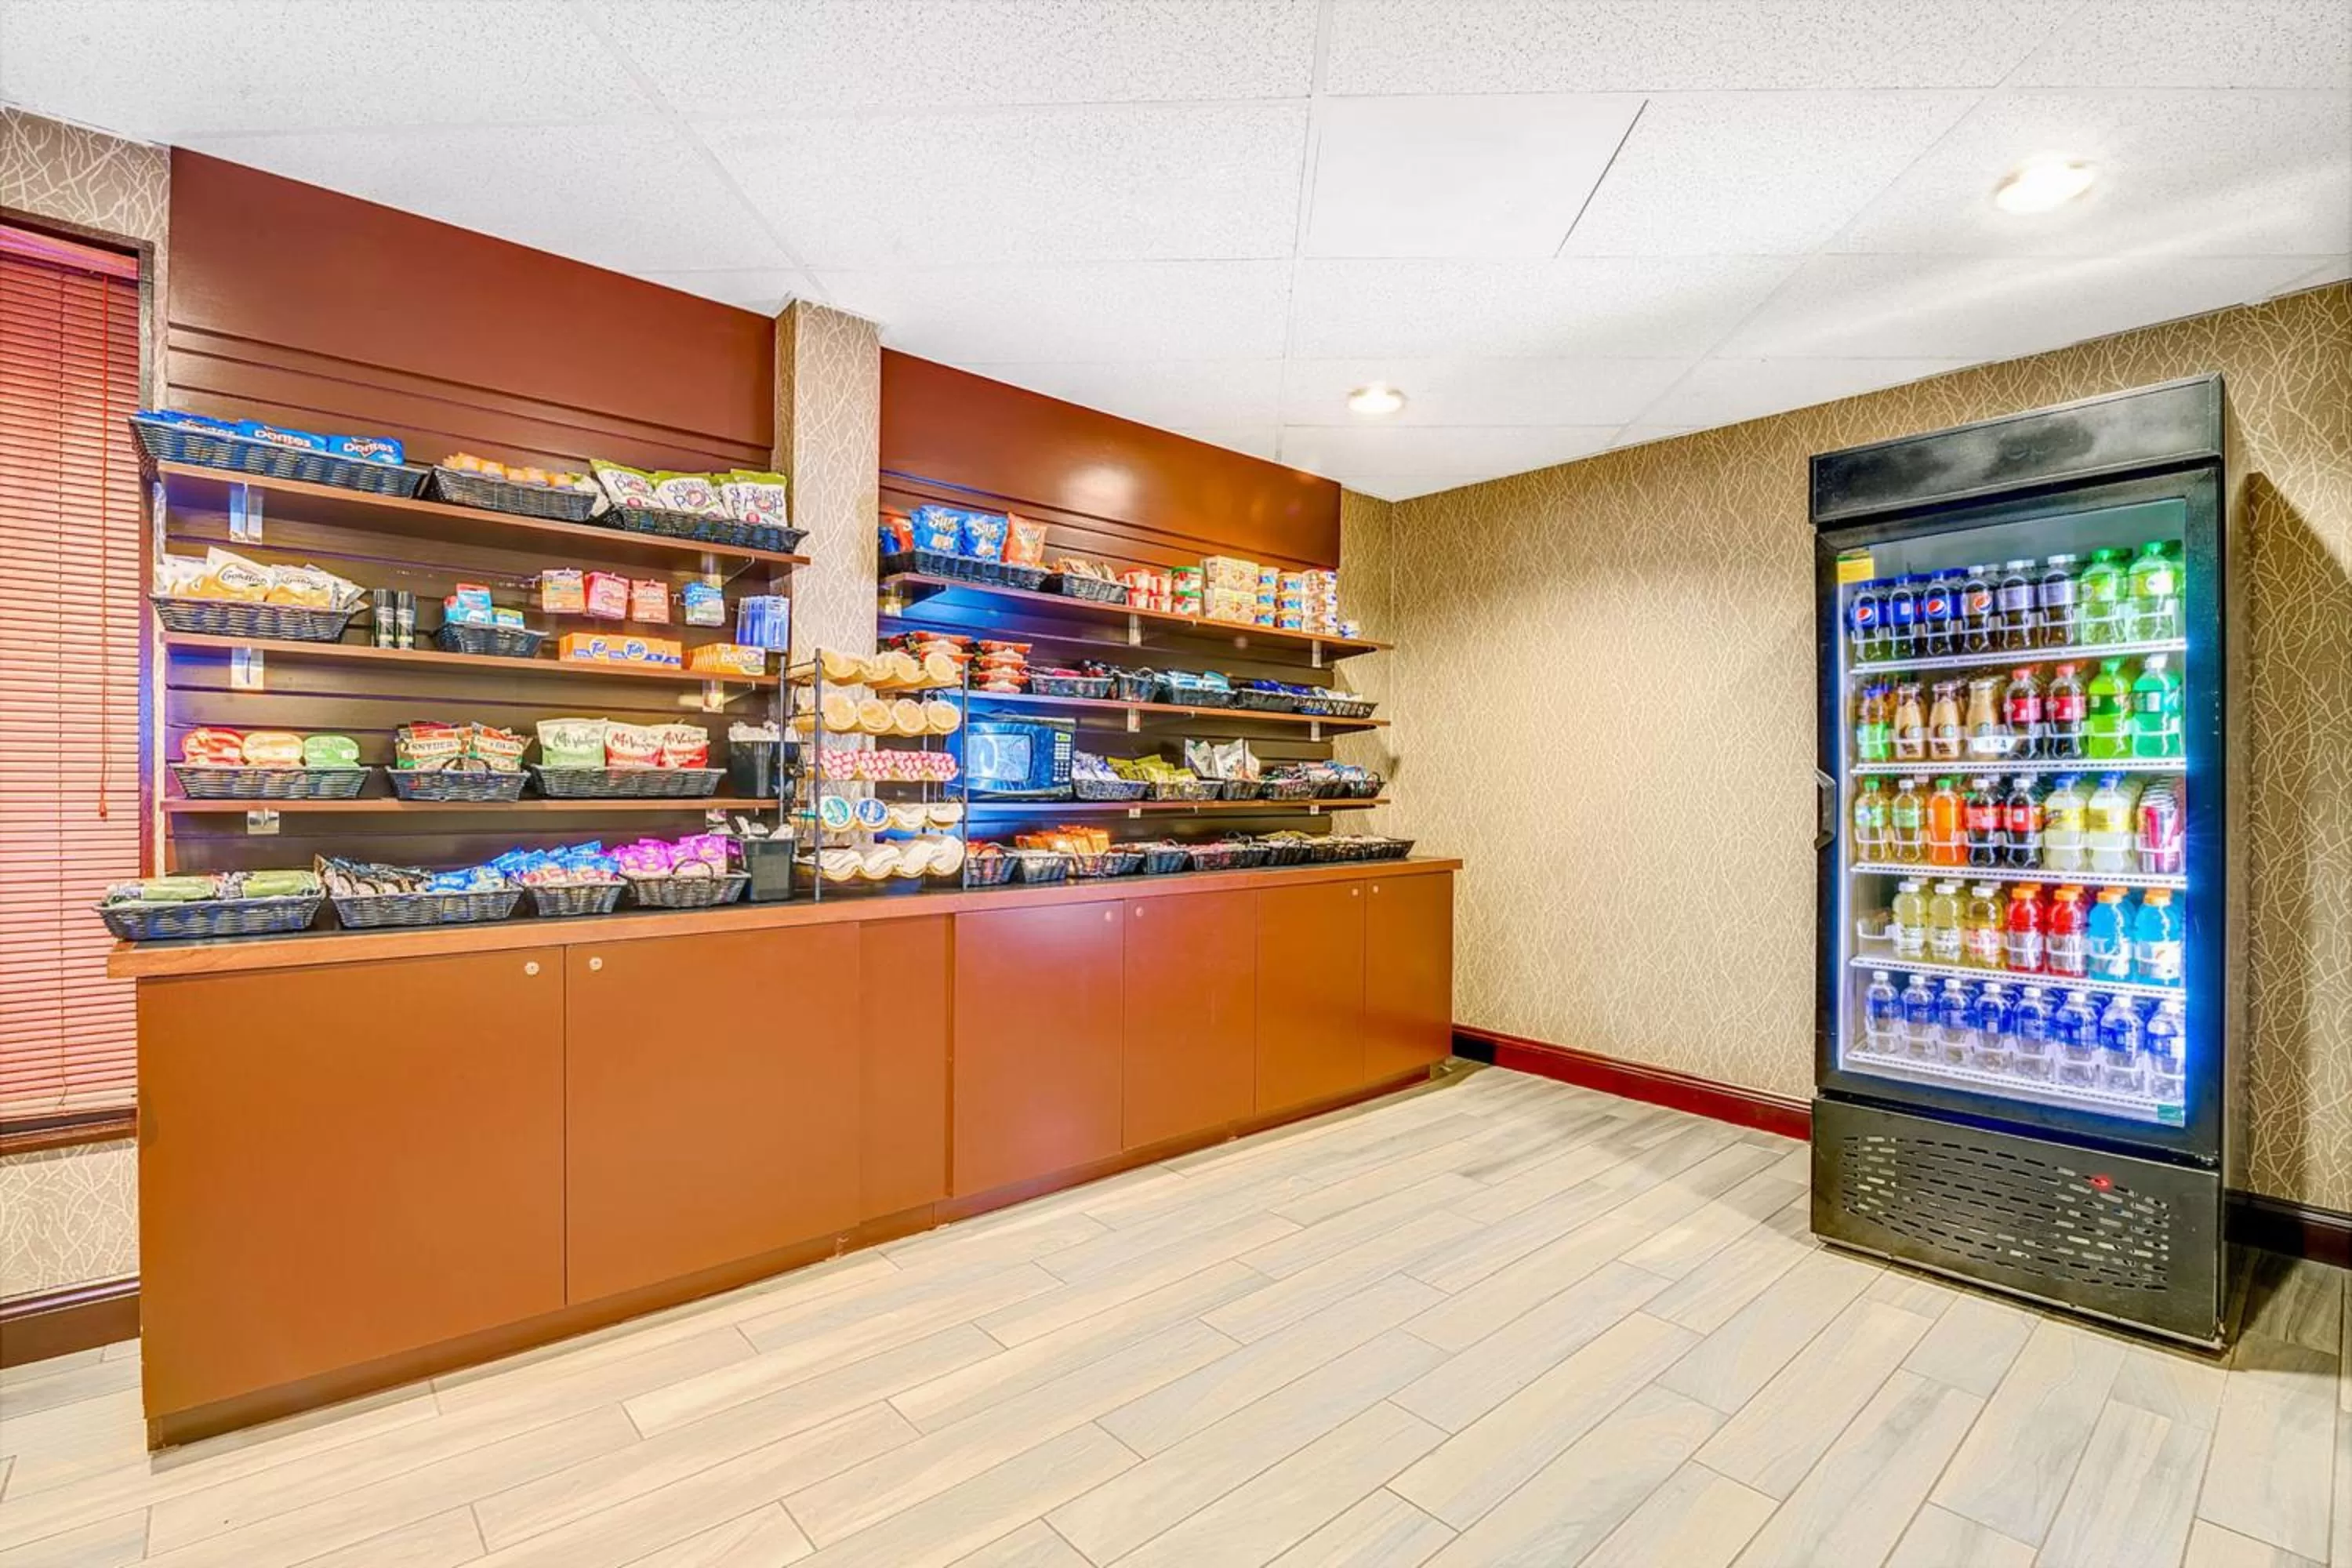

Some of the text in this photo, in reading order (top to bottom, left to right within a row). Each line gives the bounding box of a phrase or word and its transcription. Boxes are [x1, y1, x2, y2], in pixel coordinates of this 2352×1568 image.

[253, 430, 311, 448] Doritos
[343, 441, 394, 457] Doritos
[591, 643, 607, 653] Tid
